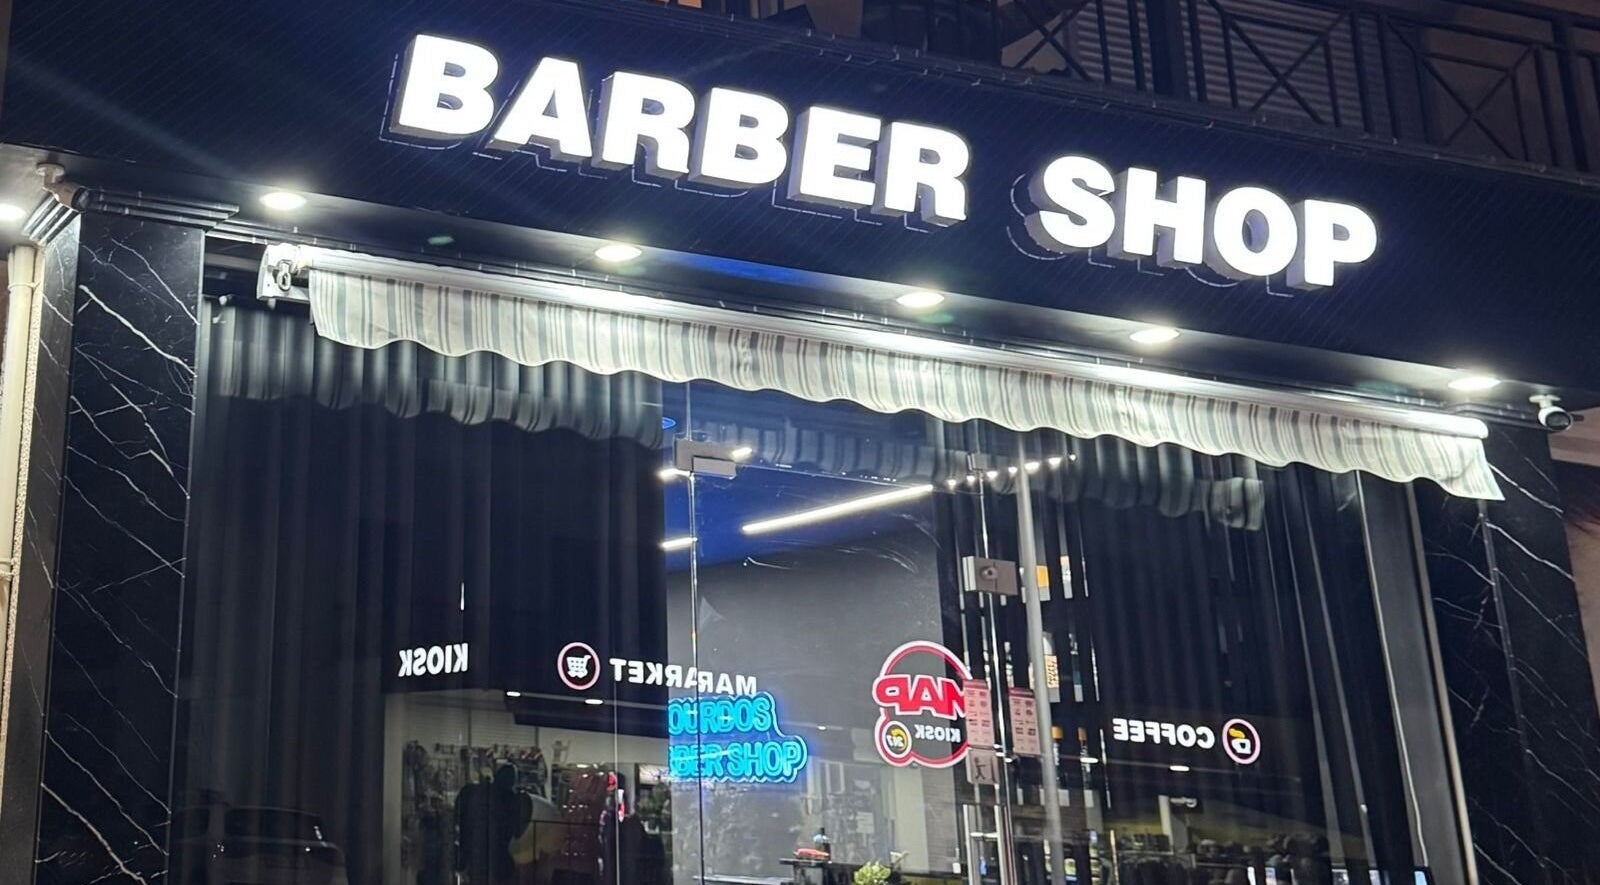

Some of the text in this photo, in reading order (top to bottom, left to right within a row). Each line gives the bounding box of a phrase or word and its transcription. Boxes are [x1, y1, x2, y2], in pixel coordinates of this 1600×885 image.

[396, 34, 1377, 287] BARBER SHOP
[726, 741, 801, 778] SHOP
